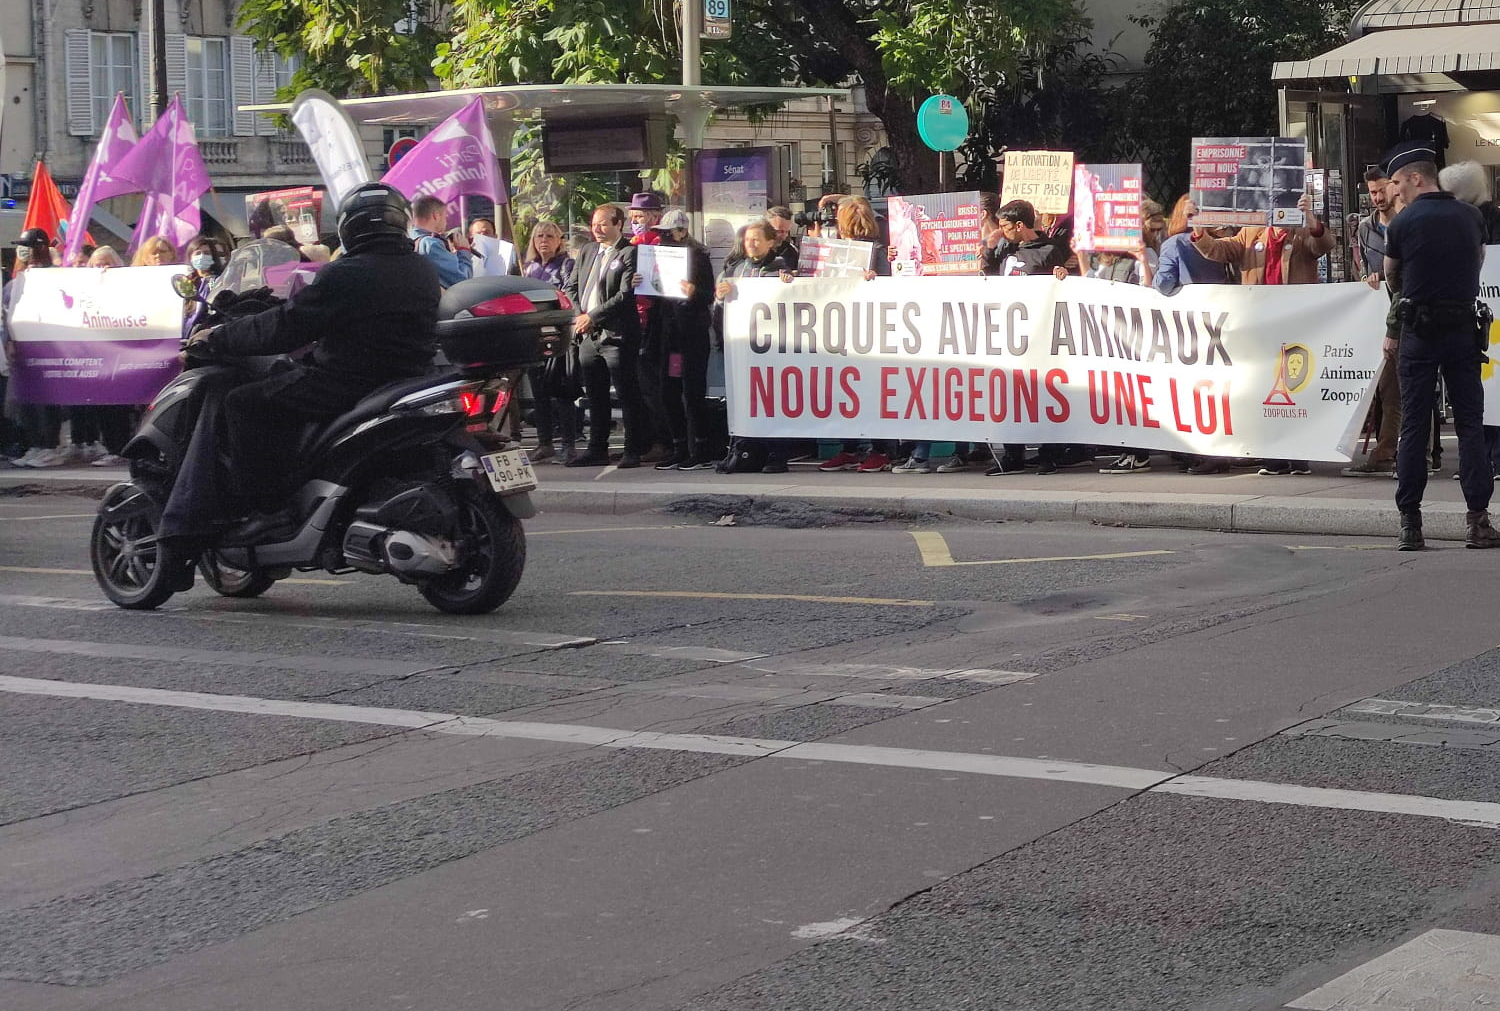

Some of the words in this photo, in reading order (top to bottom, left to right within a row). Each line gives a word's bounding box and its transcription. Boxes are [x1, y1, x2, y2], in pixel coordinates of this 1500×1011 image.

[708, 0, 725, 15] 89
[1475, 139, 1486, 147] LE
[1196, 146, 1245, 158] EMPRISONNÉ
[1008, 155, 1018, 166] LA
[1022, 154, 1061, 167] PRIVATION
[723, 165, 744, 175] Sénat
[1195, 163, 1216, 173] POUR
[1217, 163, 1238, 173] NOUS
[1195, 178, 1226, 188] AMUSER
[1043, 183, 1060, 196] PAS
[947, 231, 962, 241] POUR
[963, 231, 979, 240] FAIRE
[942, 244, 949, 254] LE
[749, 301, 922, 357] CIRQUES
[938, 301, 1028, 356] AVEC
[1050, 301, 1233, 366] ANIMAUX
[1323, 343, 1354, 358] Paris
[750, 366, 861, 419] NOUS
[879, 366, 1070, 423] EXIGEONS
[1088, 370, 1160, 429] UNE
[1169, 377, 1234, 436] LOI
[1320, 388, 1364, 405] Zoopol
[1263, 408, 1308, 418] ZOOPOLIS.FR
[494, 467, 532, 483] 490-PK
